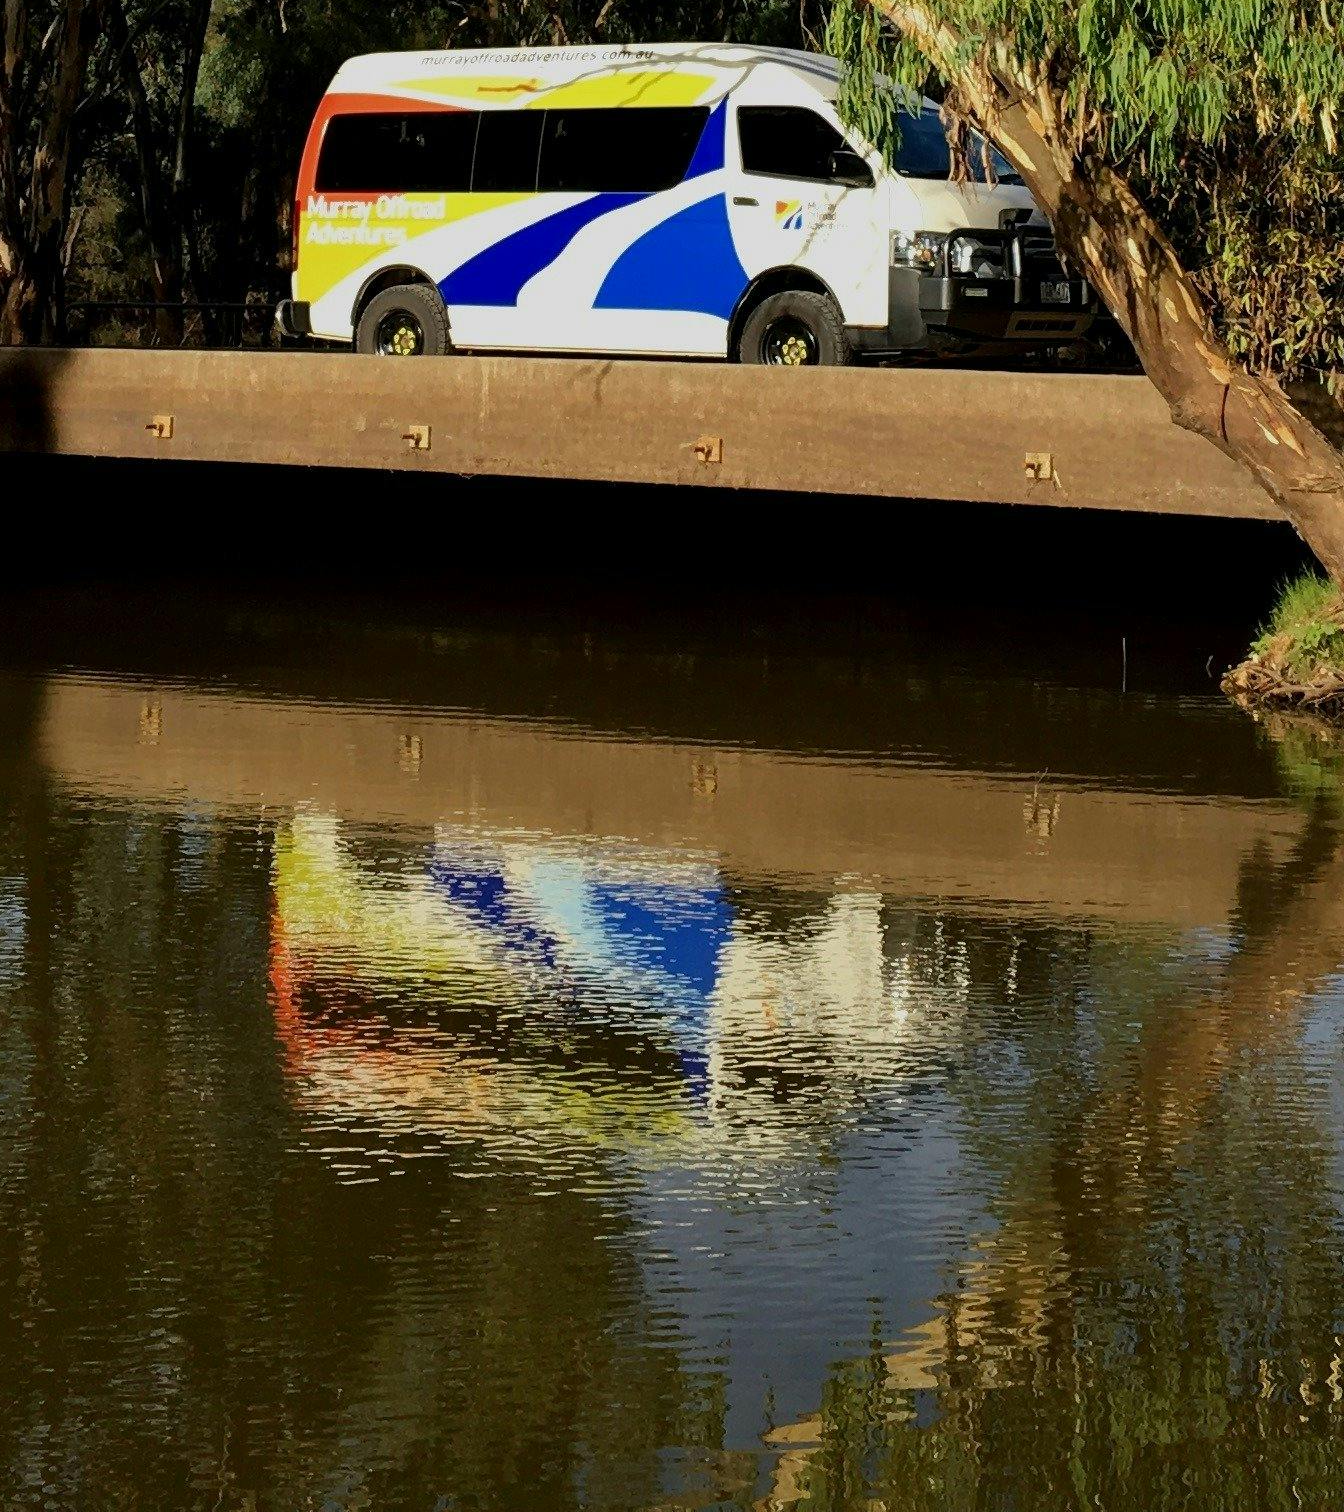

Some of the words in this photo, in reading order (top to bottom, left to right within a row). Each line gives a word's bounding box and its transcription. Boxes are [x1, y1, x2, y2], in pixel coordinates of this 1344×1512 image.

[421, 49, 655, 67] murrayoffroadadventurescomau
[307, 194, 373, 226] Murray
[376, 193, 446, 219] Offroad
[306, 220, 407, 245] Adventures
